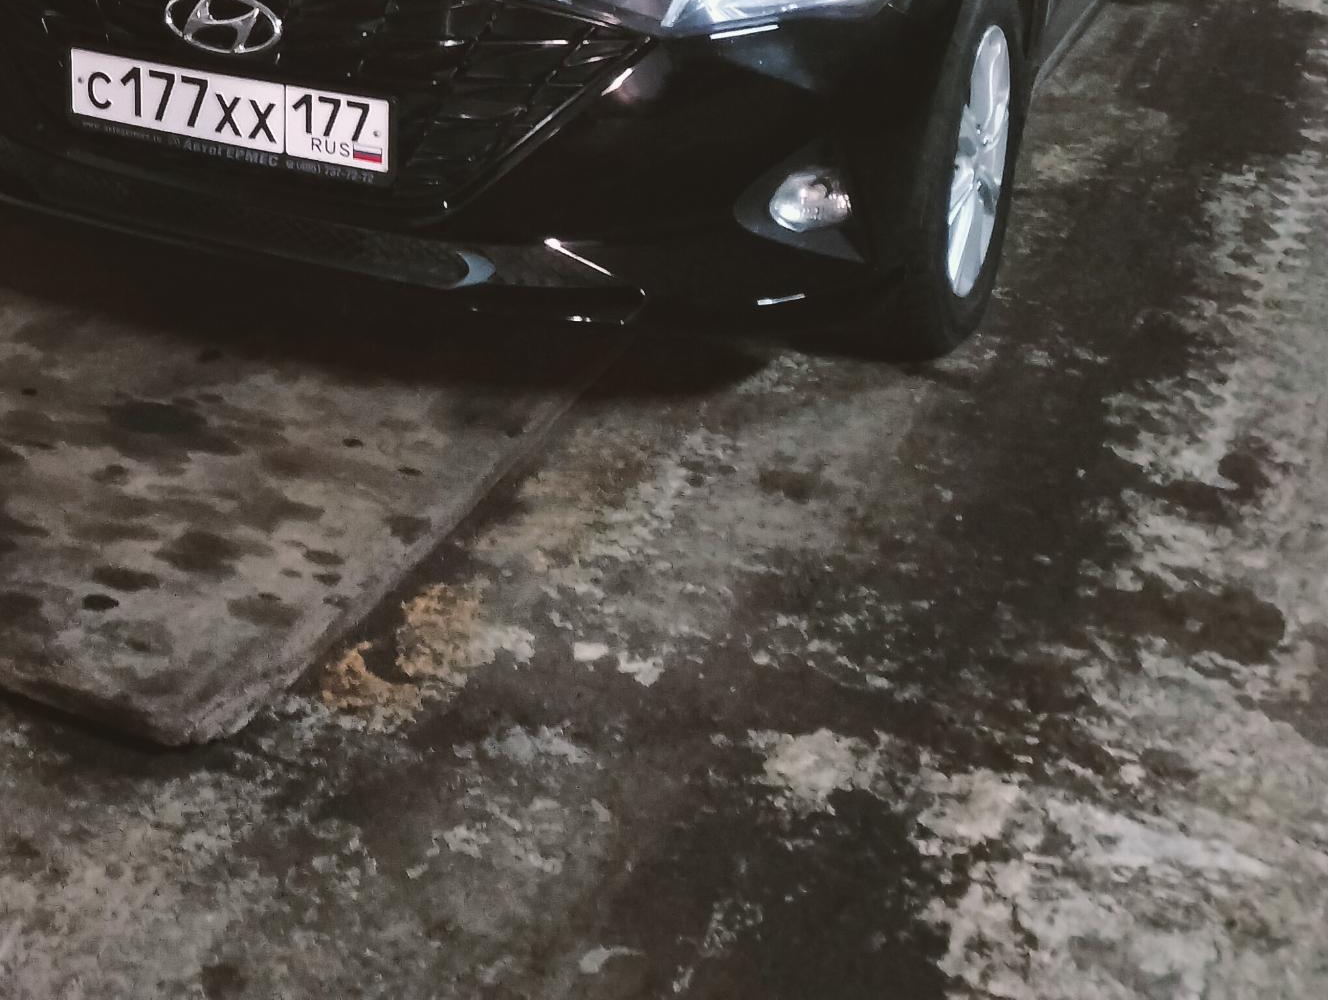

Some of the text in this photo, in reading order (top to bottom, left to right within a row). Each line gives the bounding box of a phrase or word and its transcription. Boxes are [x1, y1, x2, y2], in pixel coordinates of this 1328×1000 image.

[87, 66, 370, 143] С177ХХ 177
[310, 136, 350, 158] RUS
